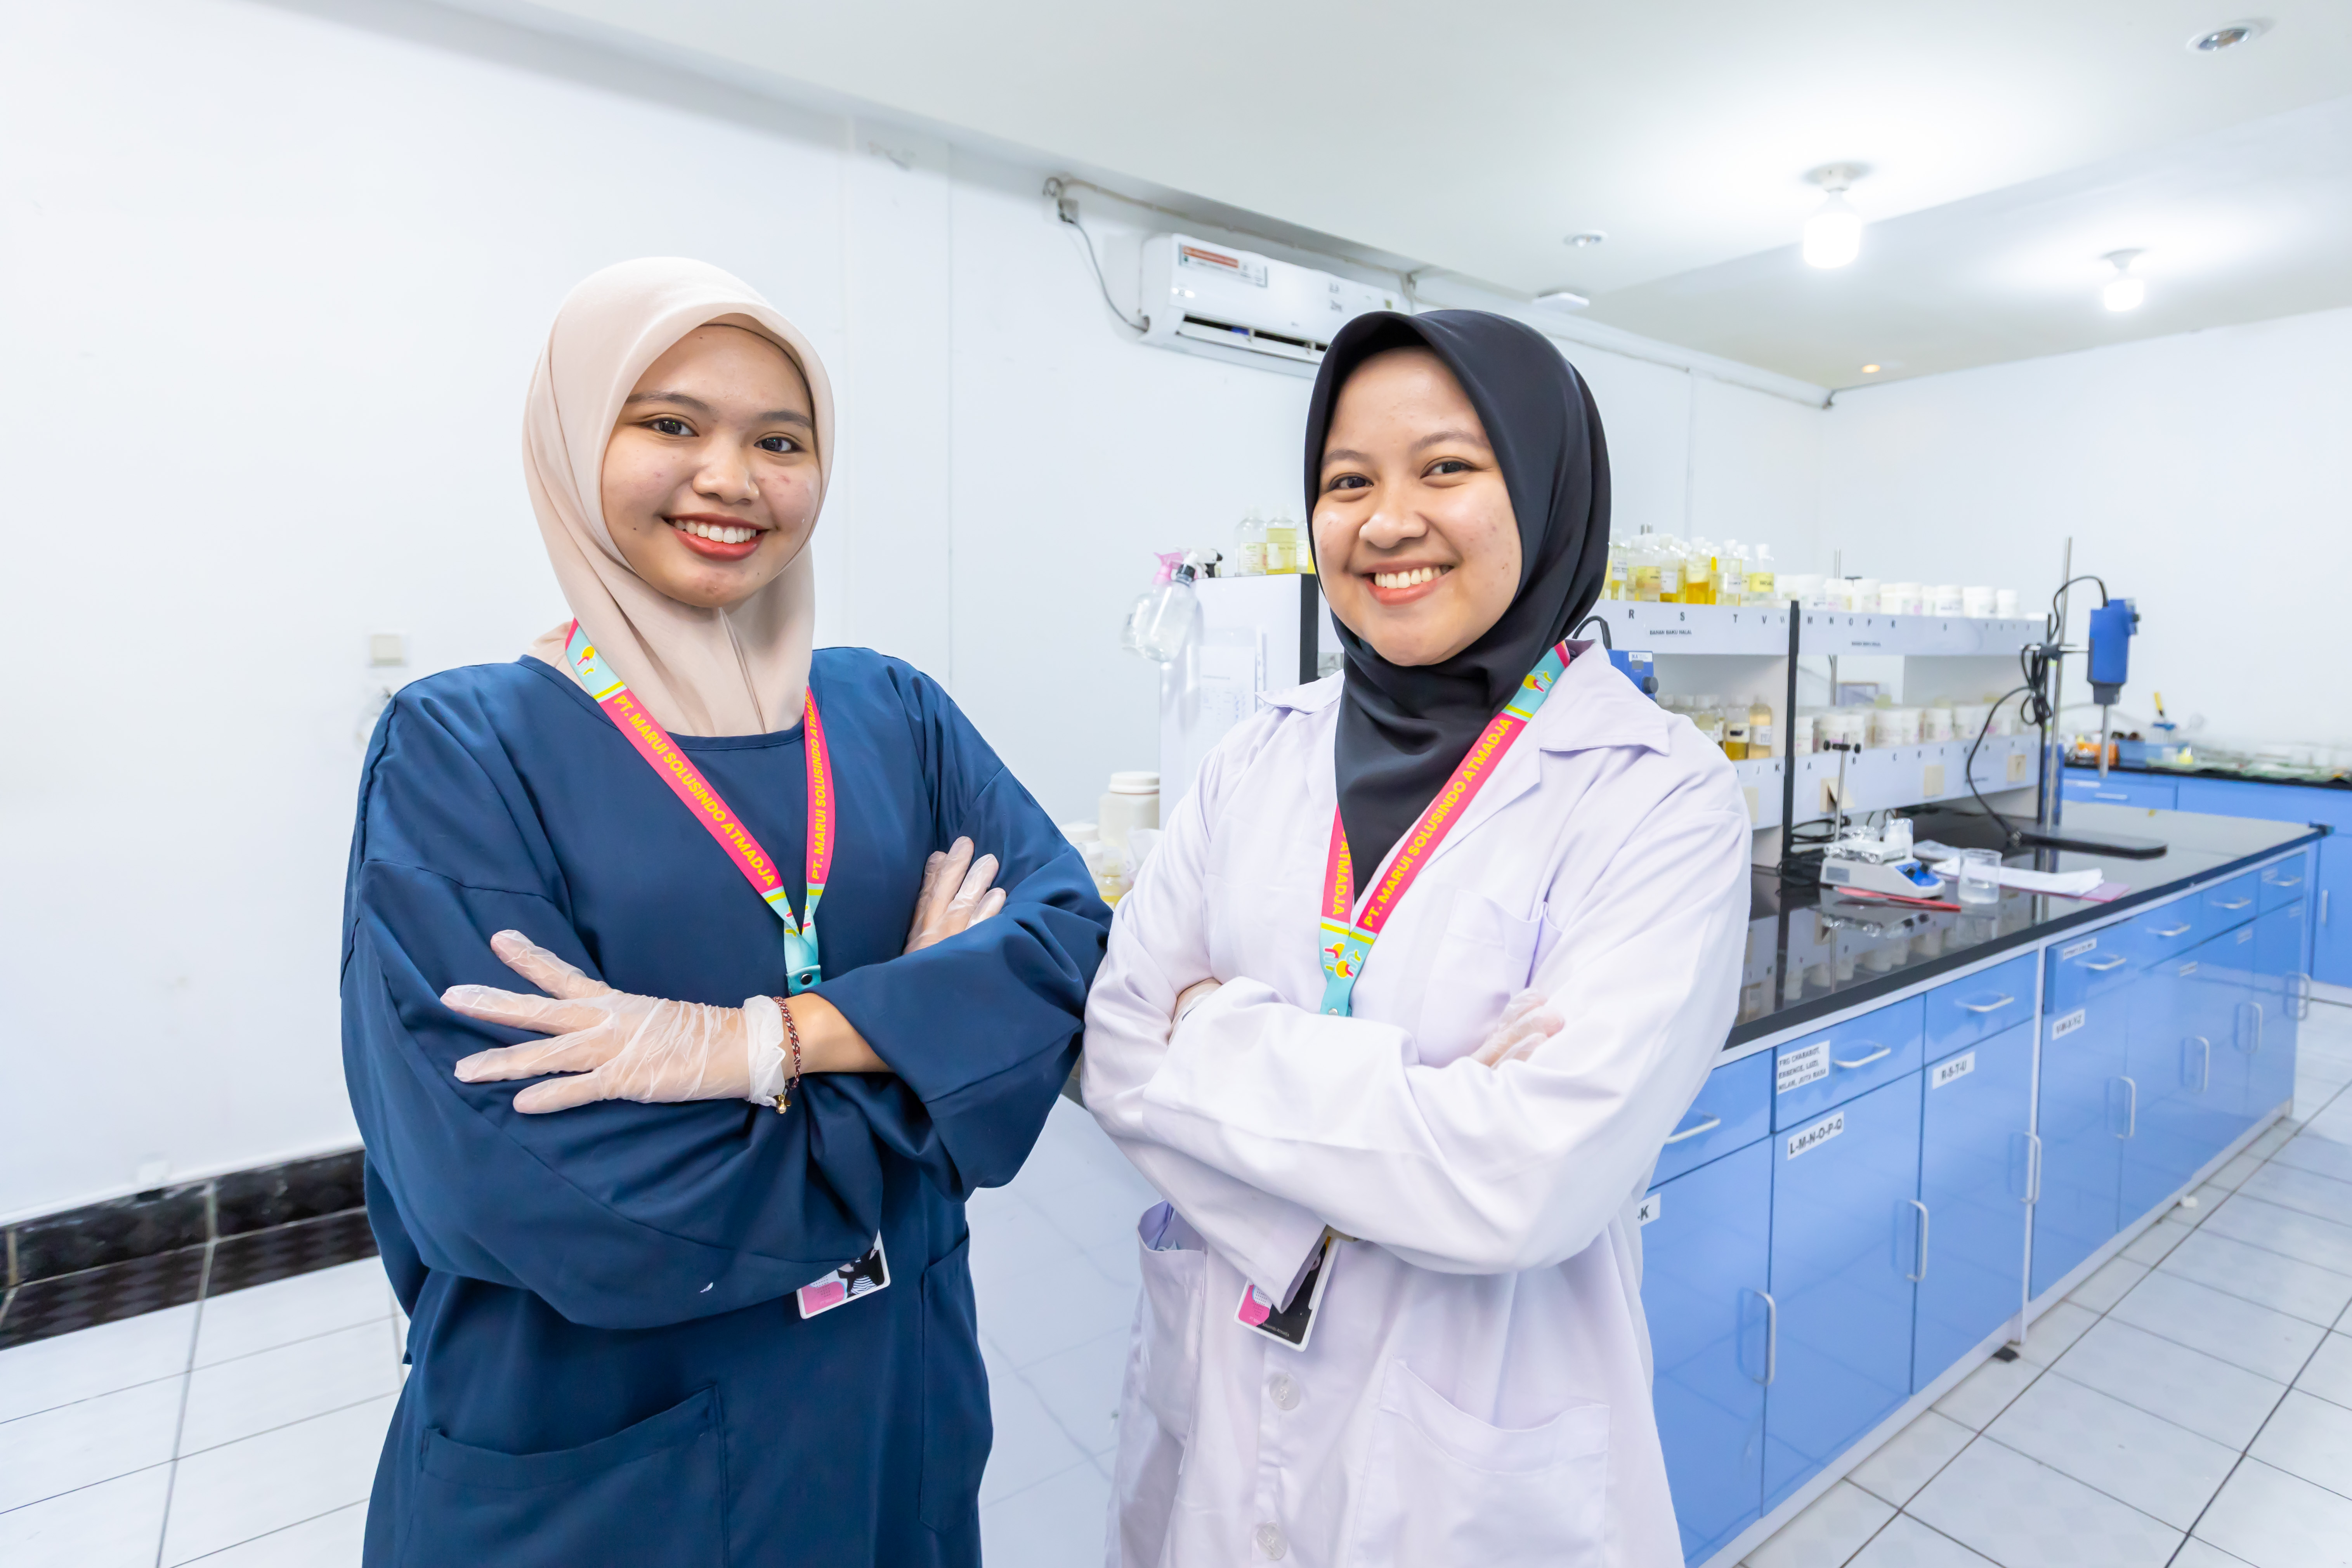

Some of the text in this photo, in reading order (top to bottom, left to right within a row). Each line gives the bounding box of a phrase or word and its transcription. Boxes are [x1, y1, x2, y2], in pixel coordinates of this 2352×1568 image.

[1629, 609, 1635, 619] R
[1680, 611, 1685, 621] S
[1733, 614, 1738, 623] T
[1762, 615, 1767, 624] V
[1807, 616, 1813, 624] M
[1829, 616, 1834, 625] N
[613, 694, 775, 886] PT. MARUI SOLUSINDO ATMADJA
[805, 689, 826, 880] PT. MARUI SOLUSINDO ATMADJ
[1775, 763, 1780, 772] K
[1363, 719, 1513, 928] PT. MARUI SOLUSINDO ATMADJA
[1332, 841, 1351, 915] ATMADJA
